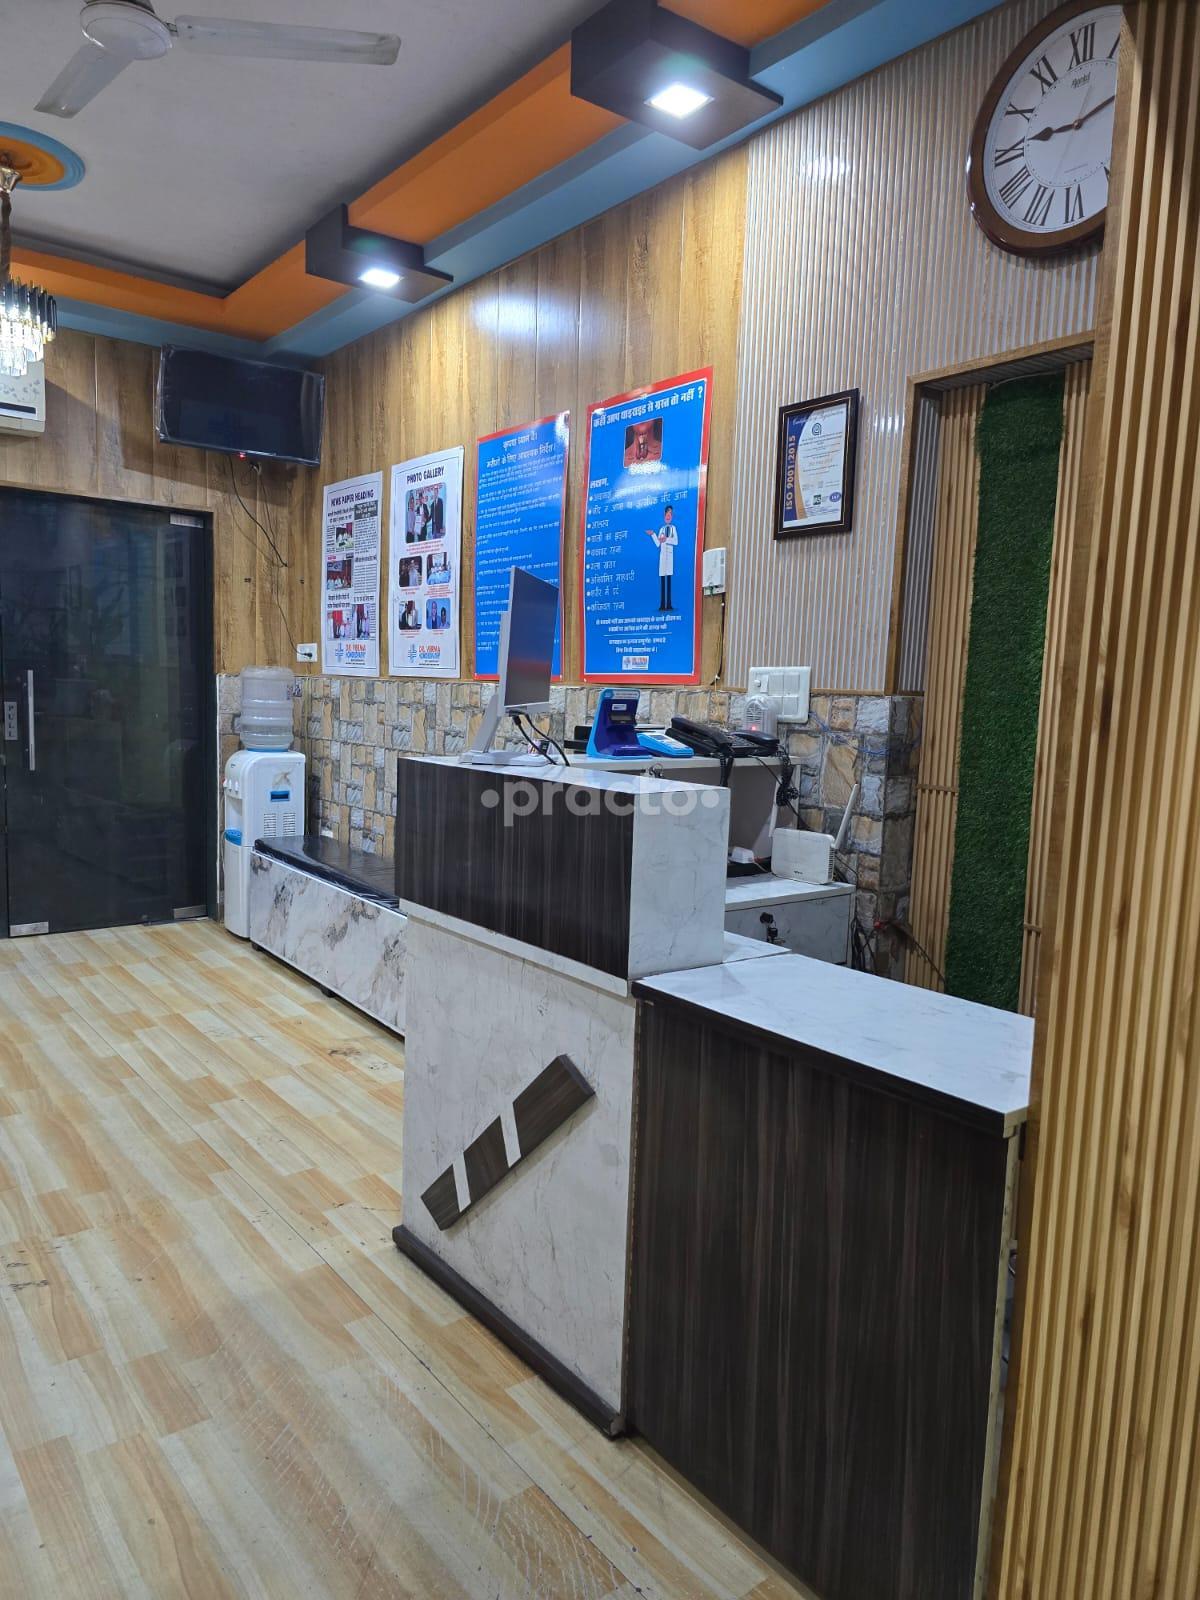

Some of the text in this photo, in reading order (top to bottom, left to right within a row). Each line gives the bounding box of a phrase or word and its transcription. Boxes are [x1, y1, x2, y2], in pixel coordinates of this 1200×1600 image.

[1067, 22, 1096, 71] XII
[1029, 55, 1059, 95] XI
[1005, 103, 1036, 122] X
[994, 136, 1026, 168] IX
[998, 166, 1034, 210] VIII
[1022, 183, 1055, 226] VII
[1063, 183, 1085, 225] VI
[406, 465, 445, 485] PHOTO GALLERY
[785, 434, 796, 511] ISO 9001:2015
[331, 488, 375, 508] NEWS PAPER HEADING
